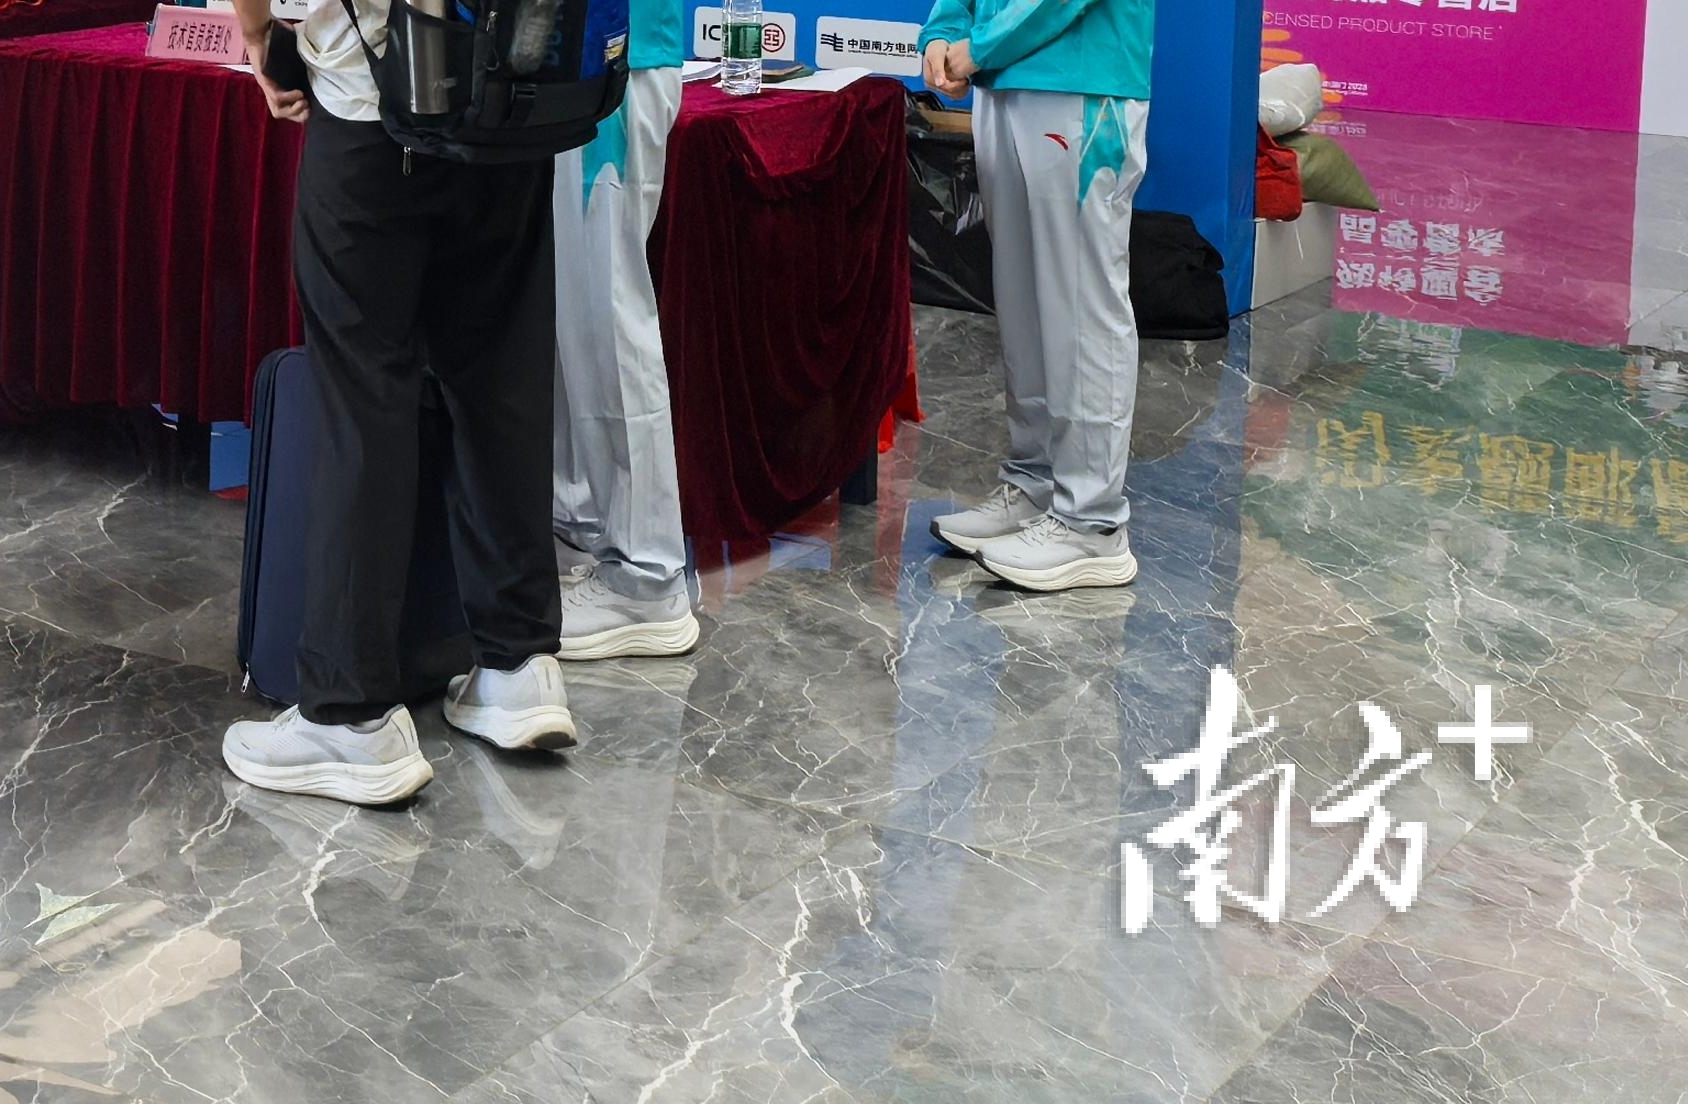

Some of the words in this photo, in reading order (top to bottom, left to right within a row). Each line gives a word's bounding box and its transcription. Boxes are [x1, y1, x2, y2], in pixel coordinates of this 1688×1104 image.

[167, 19, 233, 56] 技术官员报到处
[1263, 10, 1334, 30] CENSED
[1337, 15, 1428, 36] PRODUCT
[1431, 22, 1494, 40] STORE
[847, 38, 919, 55] 中国南方电网
